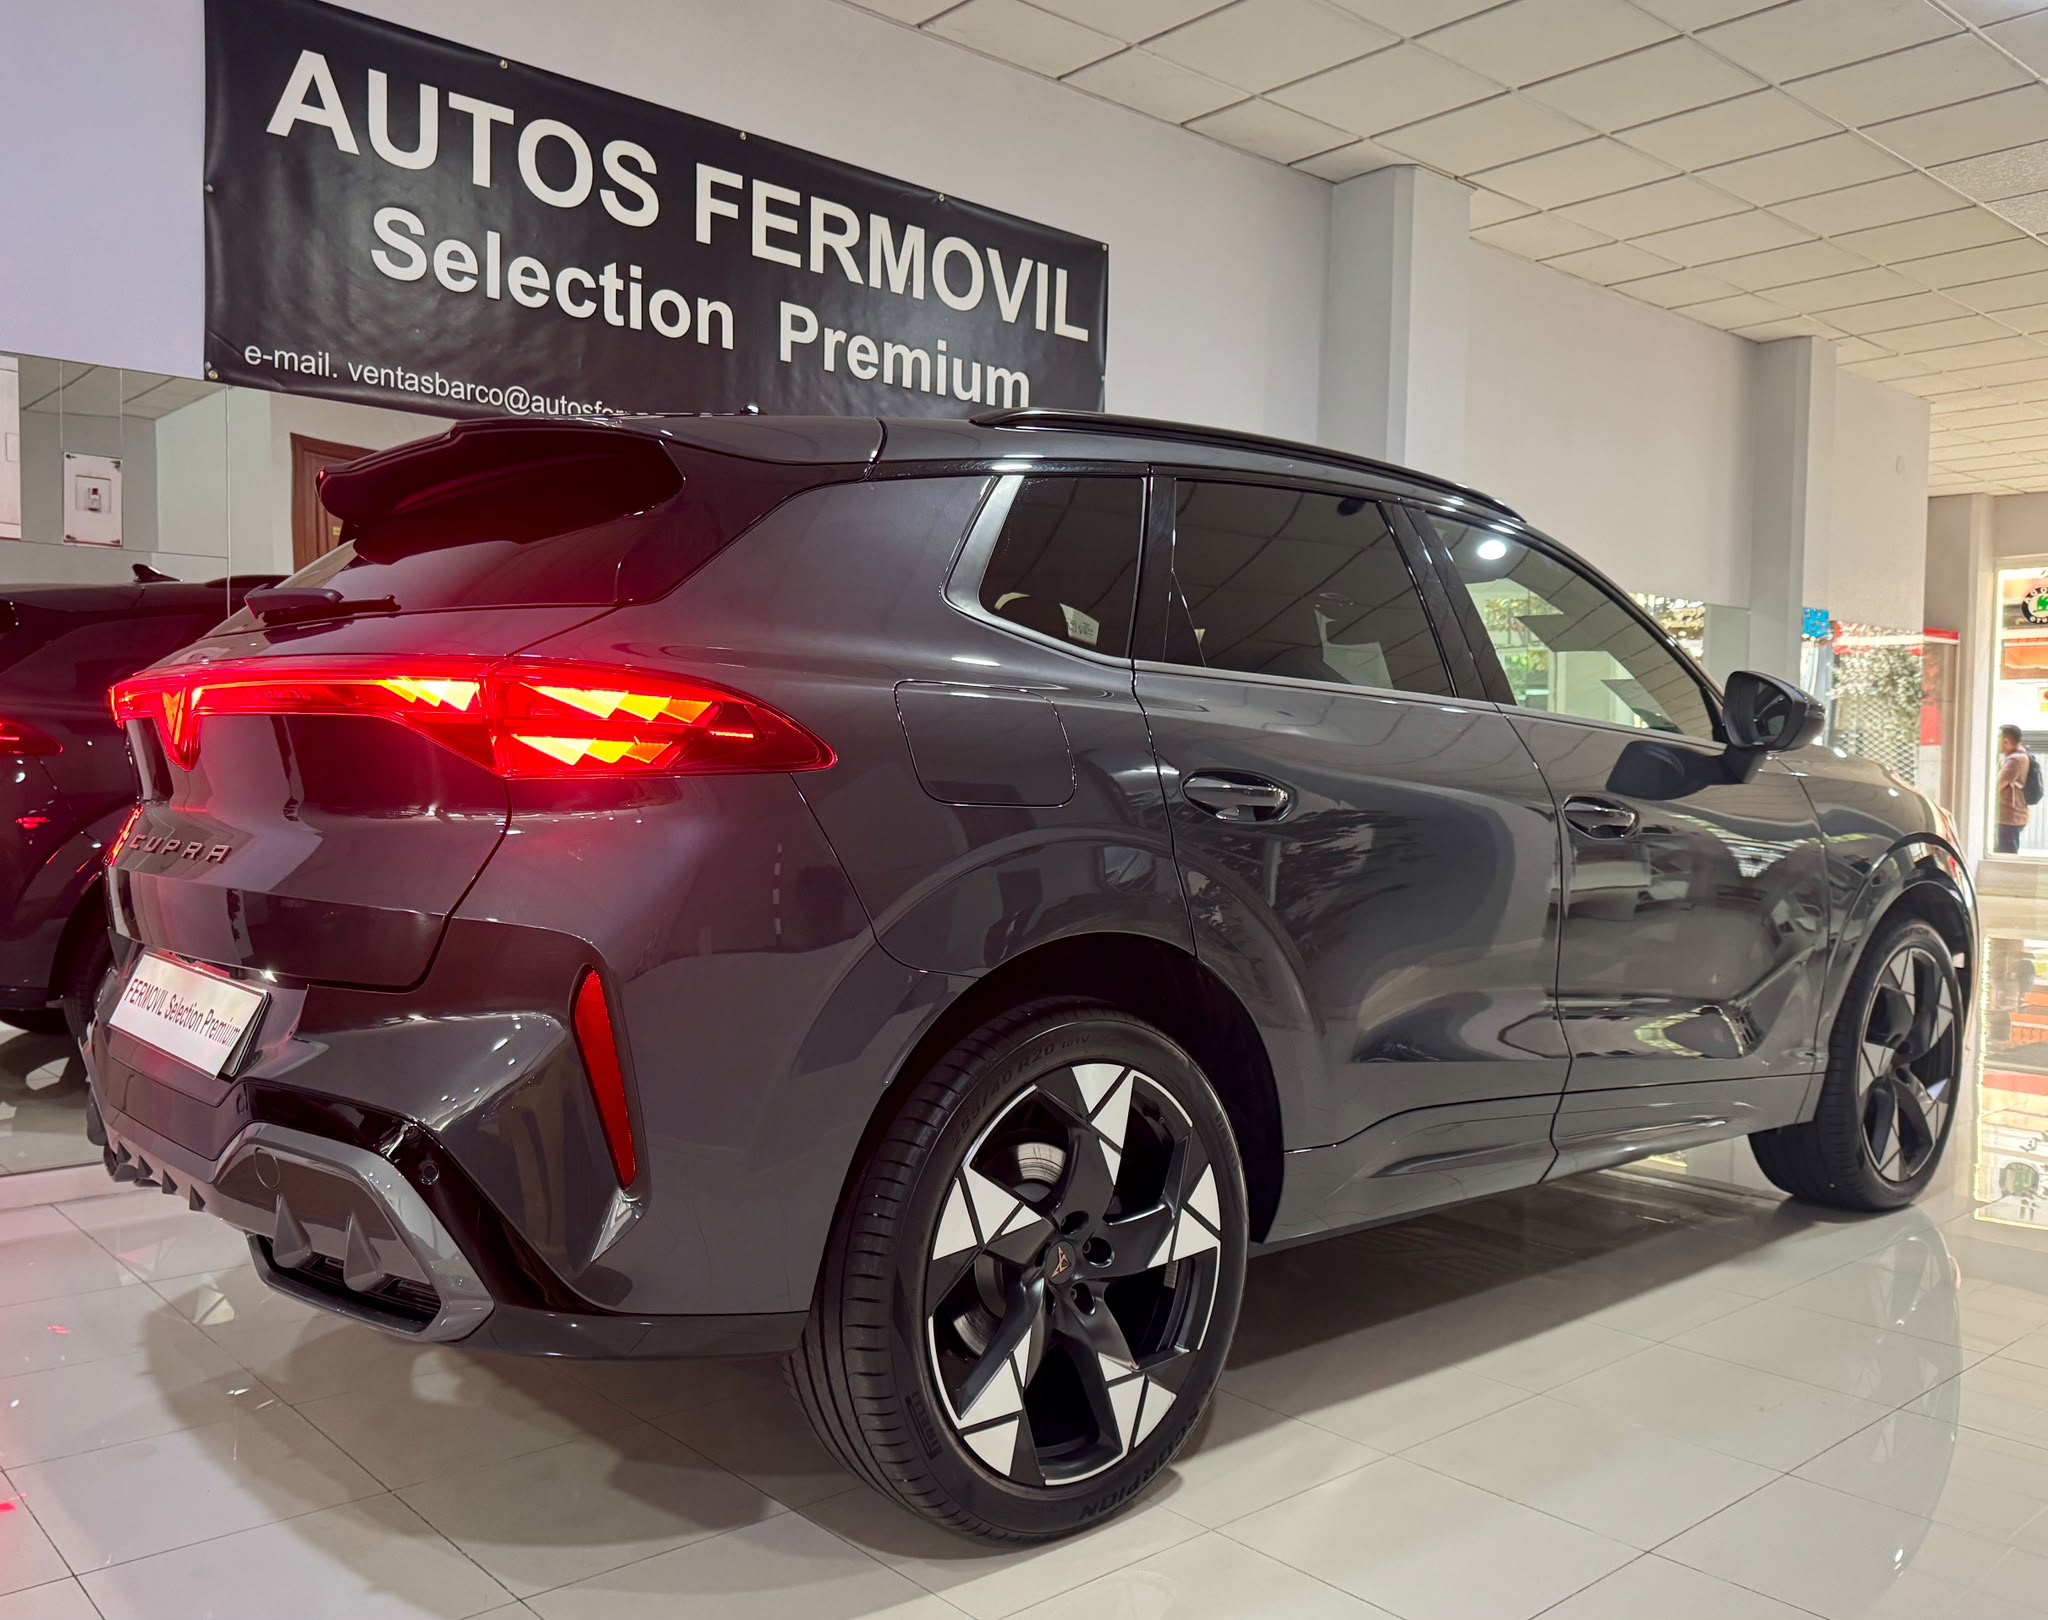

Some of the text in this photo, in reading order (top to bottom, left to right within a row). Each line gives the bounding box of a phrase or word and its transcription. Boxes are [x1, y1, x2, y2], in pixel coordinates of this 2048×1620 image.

[266, 49, 1090, 343] AUTOS FERMOVIL
[370, 206, 1031, 409] Selection Premium
[243, 341, 340, 381] e-mail.
[128, 834, 232, 864] CUPRA
[124, 978, 241, 1049] FERMOVIL Selection Premium
[1017, 1041, 1056, 1073] R20
[1078, 1408, 1200, 1521] SCORPION
